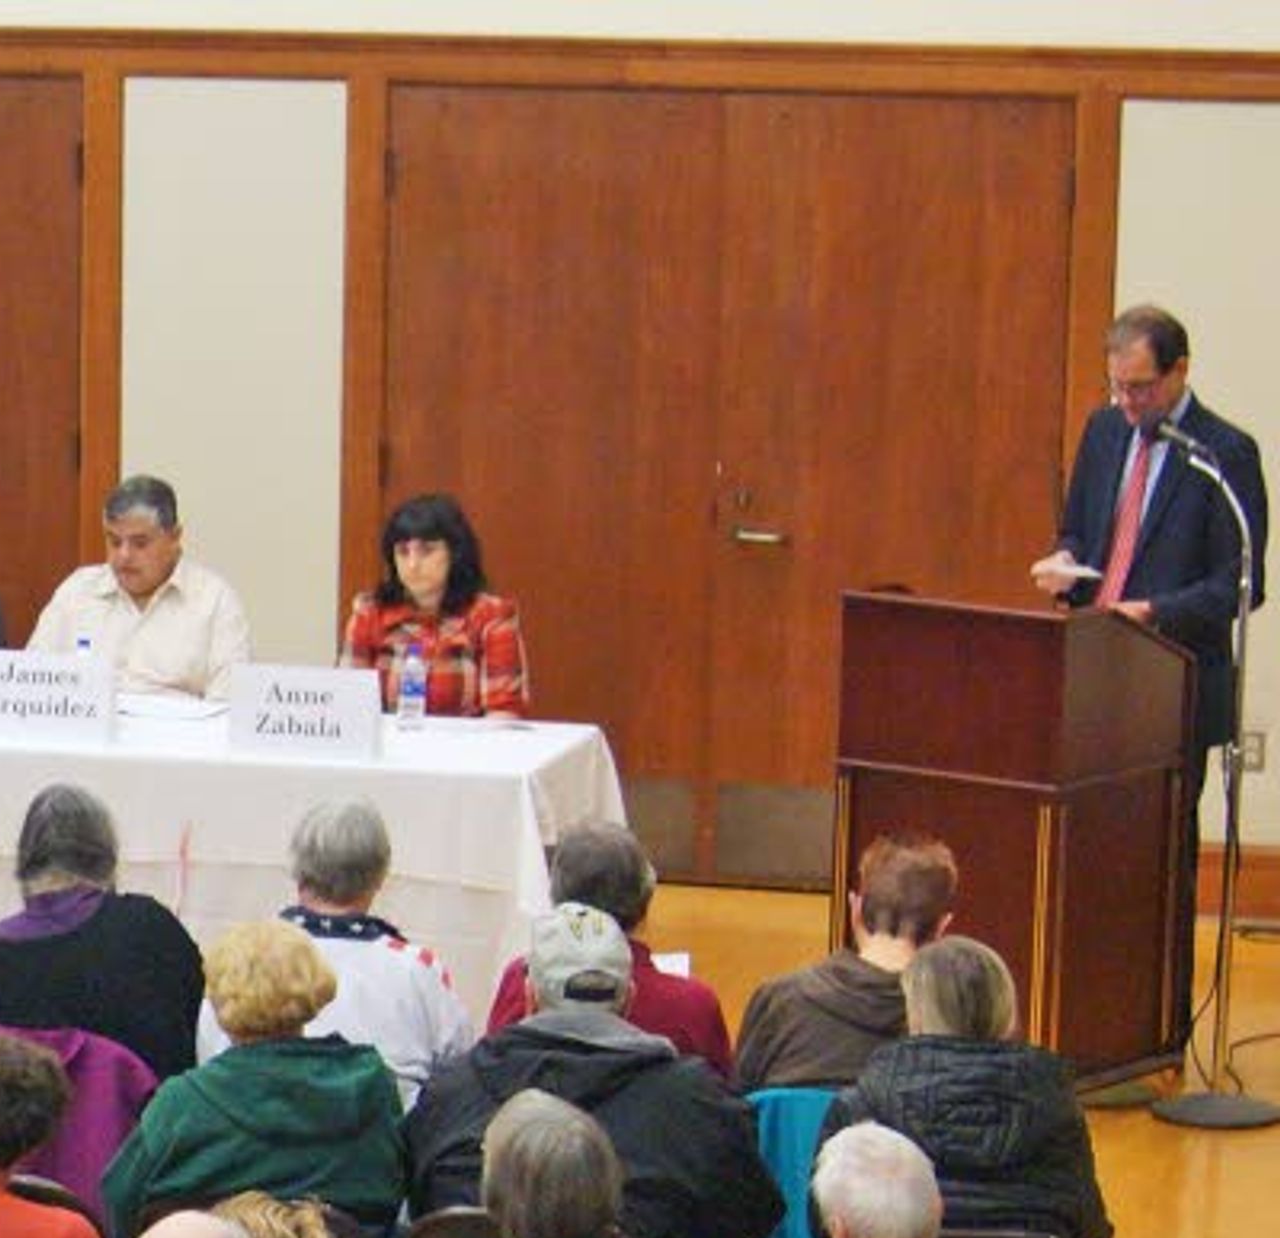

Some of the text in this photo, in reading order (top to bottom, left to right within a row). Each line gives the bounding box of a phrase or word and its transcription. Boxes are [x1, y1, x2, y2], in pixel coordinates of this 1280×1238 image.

[0, 662, 80, 685] James
[266, 682, 334, 704] Anne
[255, 712, 343, 738] Zabala
